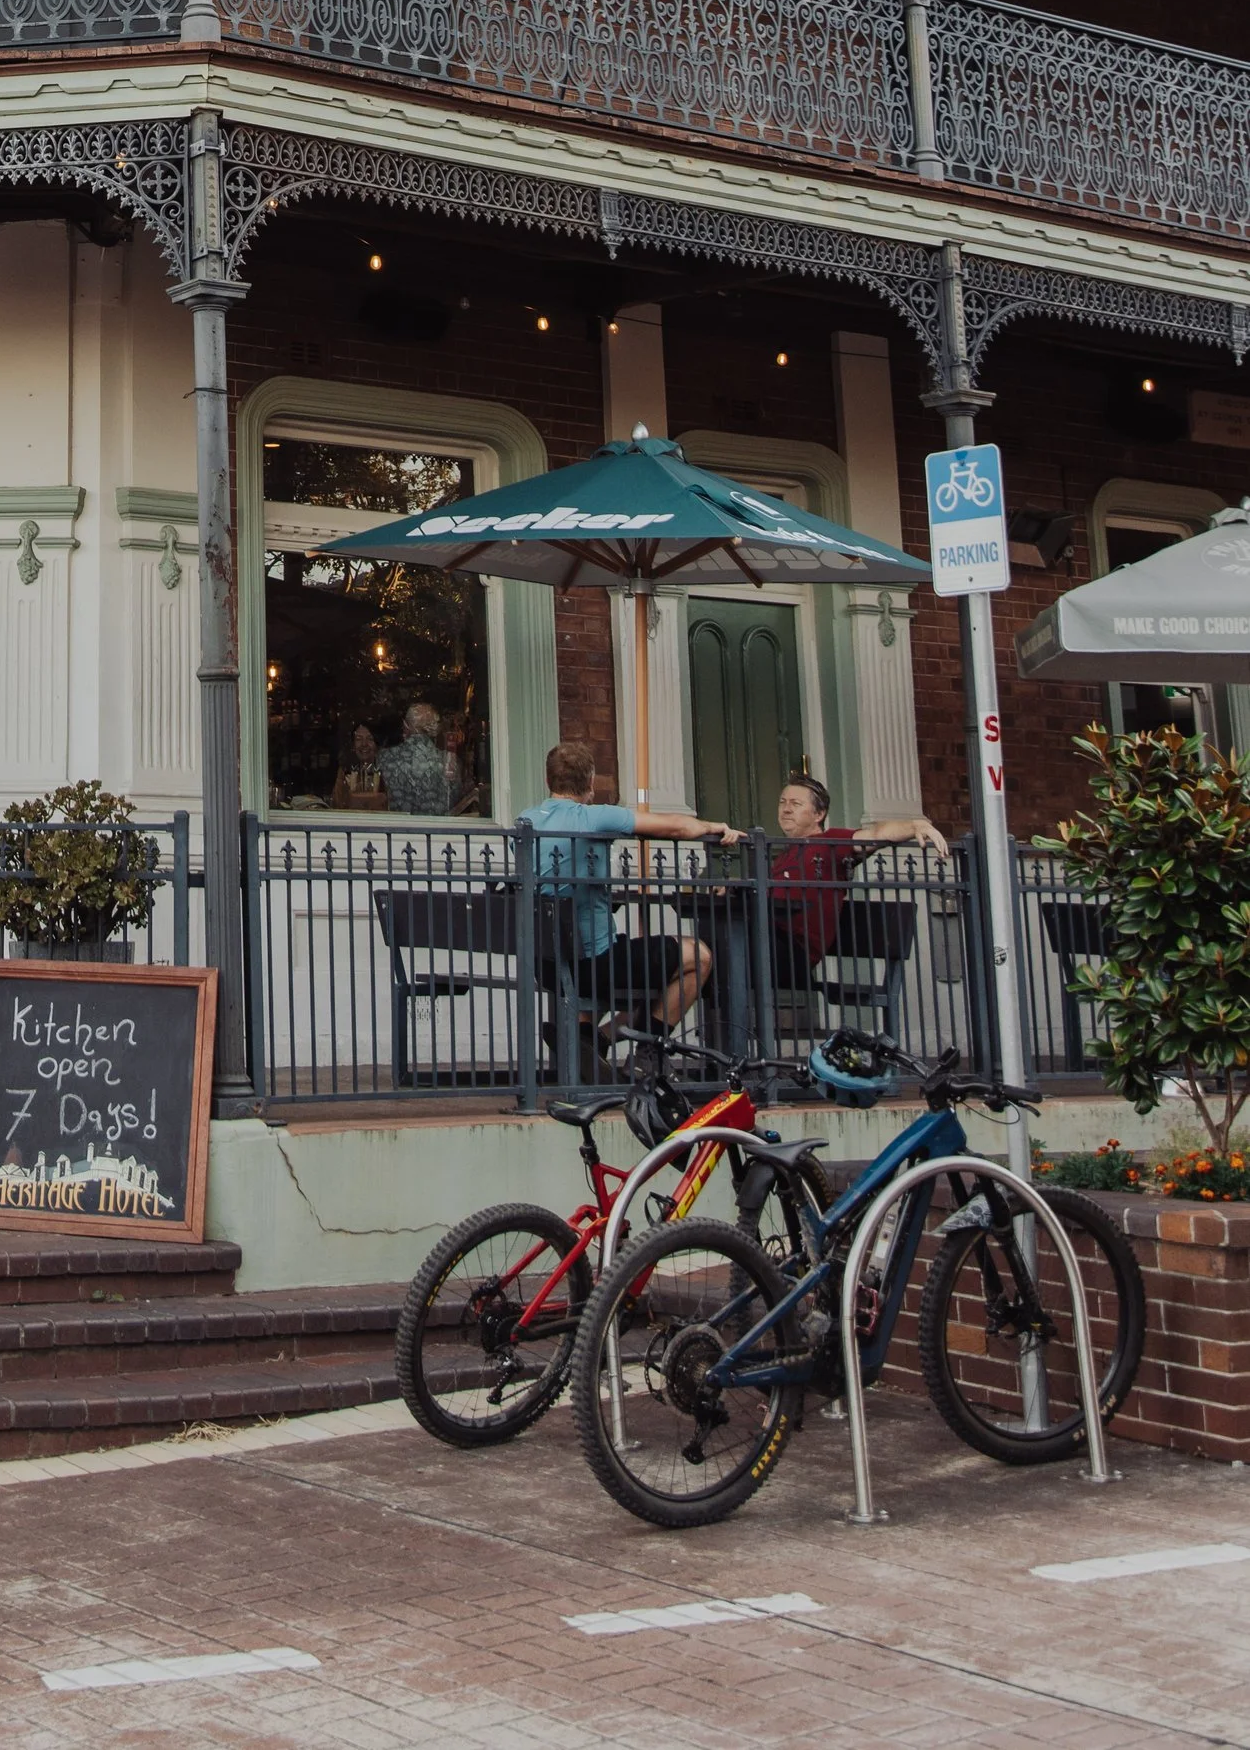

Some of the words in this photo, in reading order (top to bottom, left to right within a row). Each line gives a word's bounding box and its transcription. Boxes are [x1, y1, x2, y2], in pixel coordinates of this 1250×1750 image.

[939, 541, 999, 568] PARKING
[1113, 617, 1155, 635] MAKE
[1159, 617, 1199, 635] GOOD
[12, 996, 138, 1056] Kitchen
[37, 1056, 122, 1092] open
[5, 1088, 38, 1141] 7
[59, 1088, 158, 1142] Days!
[98, 1177, 167, 1218] HOTEL
